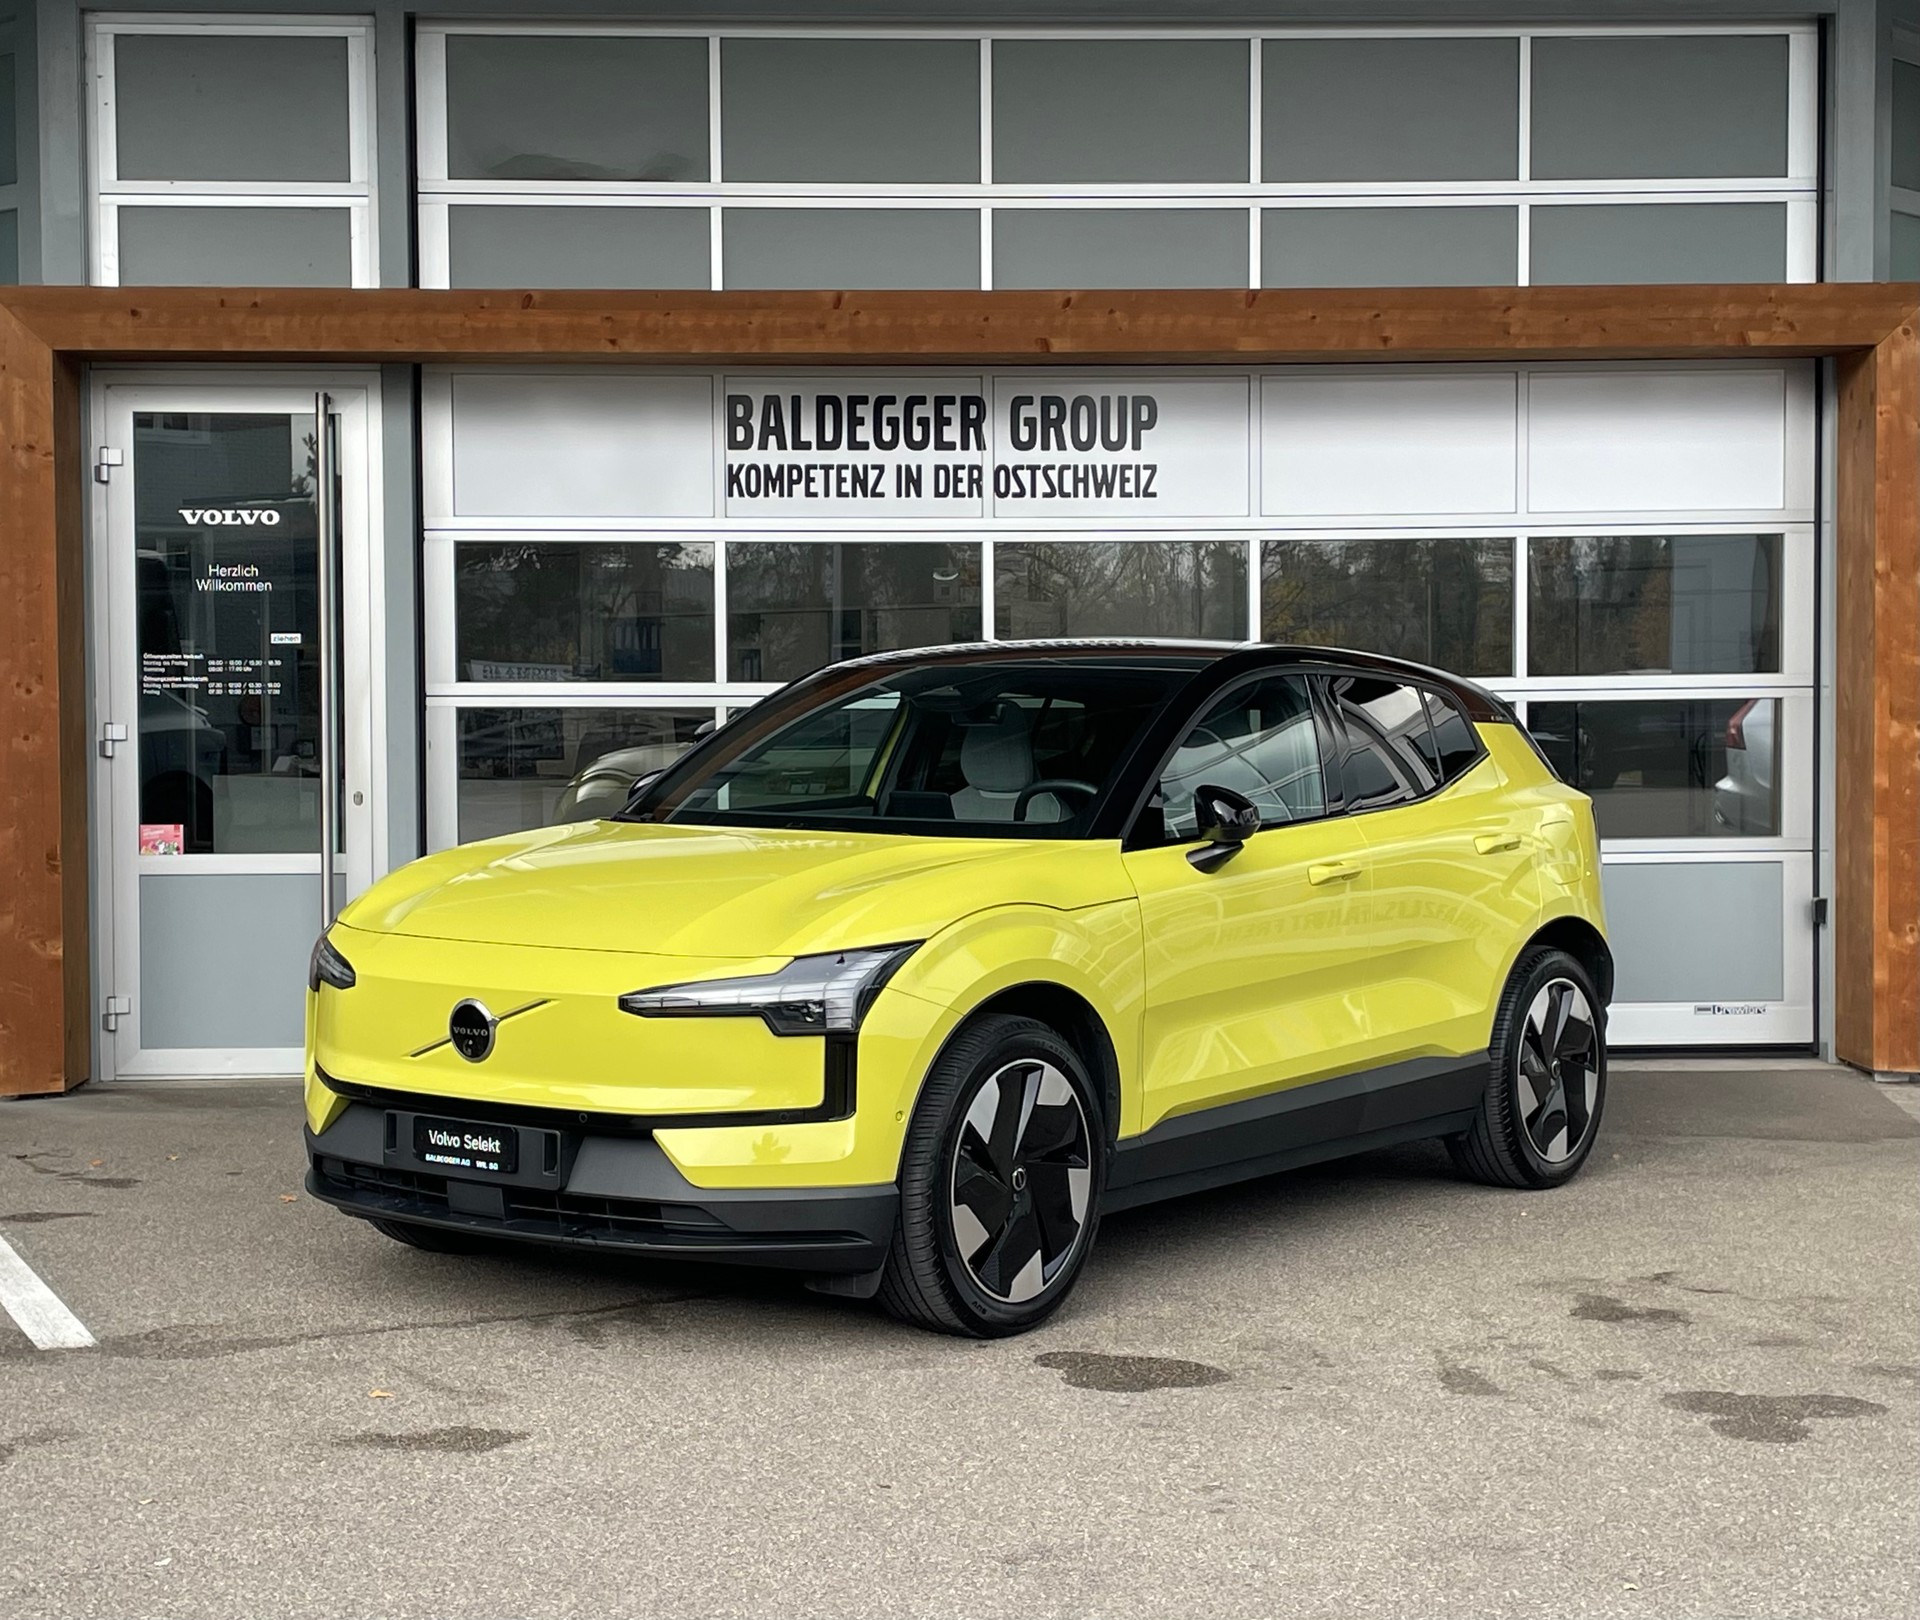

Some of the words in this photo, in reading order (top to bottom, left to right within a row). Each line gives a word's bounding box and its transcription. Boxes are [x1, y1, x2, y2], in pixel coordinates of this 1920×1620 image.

[726, 394, 987, 451] BALDEGGER
[1010, 395, 1158, 452] GROUP
[727, 463, 885, 498] KOMPETENZ
[896, 464, 922, 498] IN
[934, 464, 983, 498] DER
[994, 464, 1158, 498] OSTSCHWEIZ
[178, 509, 280, 525] VOLVO
[208, 564, 259, 577] Herzlich
[196, 579, 272, 591] Willkommen
[453, 1026, 488, 1036] VOLVO
[428, 1129, 460, 1148] Volvo
[463, 1134, 501, 1153] Selekt
